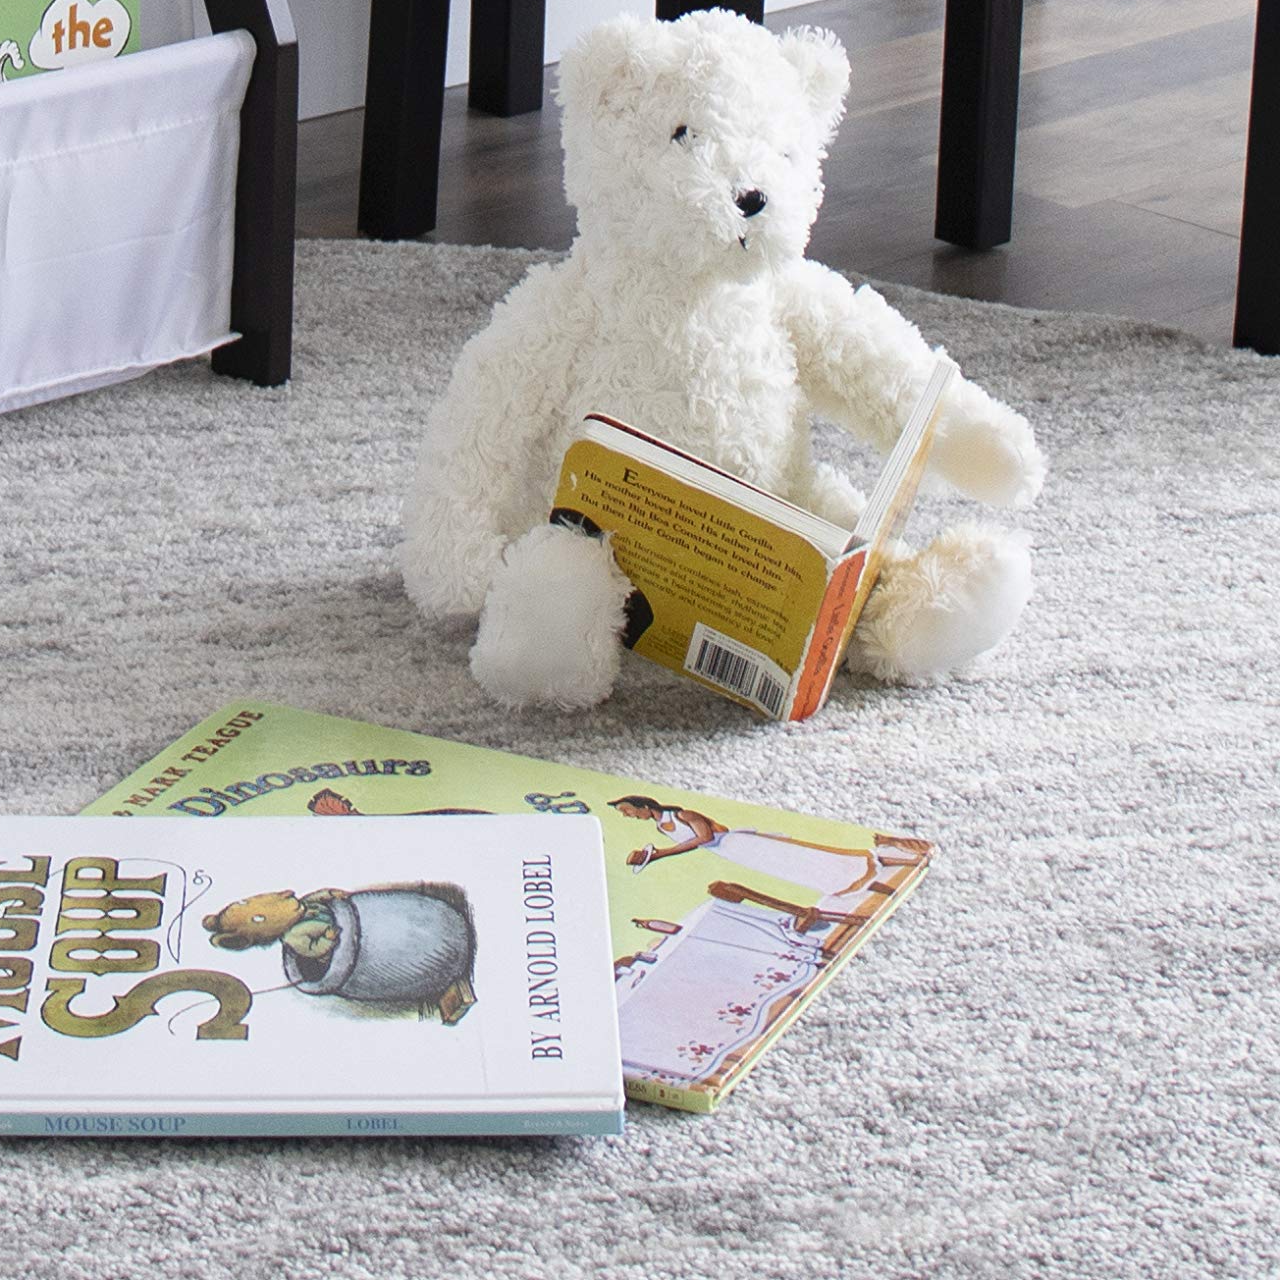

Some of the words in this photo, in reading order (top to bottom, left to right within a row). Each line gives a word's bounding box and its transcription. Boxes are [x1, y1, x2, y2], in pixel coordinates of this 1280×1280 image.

[52, 3, 115, 56] the
[579, 492, 600, 507] But
[601, 503, 625, 519] then
[626, 514, 654, 533] Little
[654, 528, 691, 550] Gorilla
[691, 545, 725, 567] began
[583, 469, 603, 483] His
[603, 479, 643, 502] mother
[643, 497, 673, 516] loved
[699, 523, 718, 537] His
[719, 533, 751, 553] father
[752, 549, 783, 568] loved
[621, 468, 676, 505] Everyone
[678, 500, 707, 519] loved
[708, 514, 736, 533] Little
[730, 551, 760, 570] loved
[123, 766, 193, 808] MARK
[181, 709, 265, 763] TEAGUE
[166, 758, 433, 818] Dinosaurs
[522, 854, 555, 924] LOBEL
[40, 856, 254, 1041] SOUP
[526, 930, 562, 1023] ARNOLD
[531, 1031, 563, 1061] BY
[44, 1115, 121, 1133] MOUSE
[127, 1115, 188, 1133] SOUP
[346, 1117, 401, 1131] LOBEL
